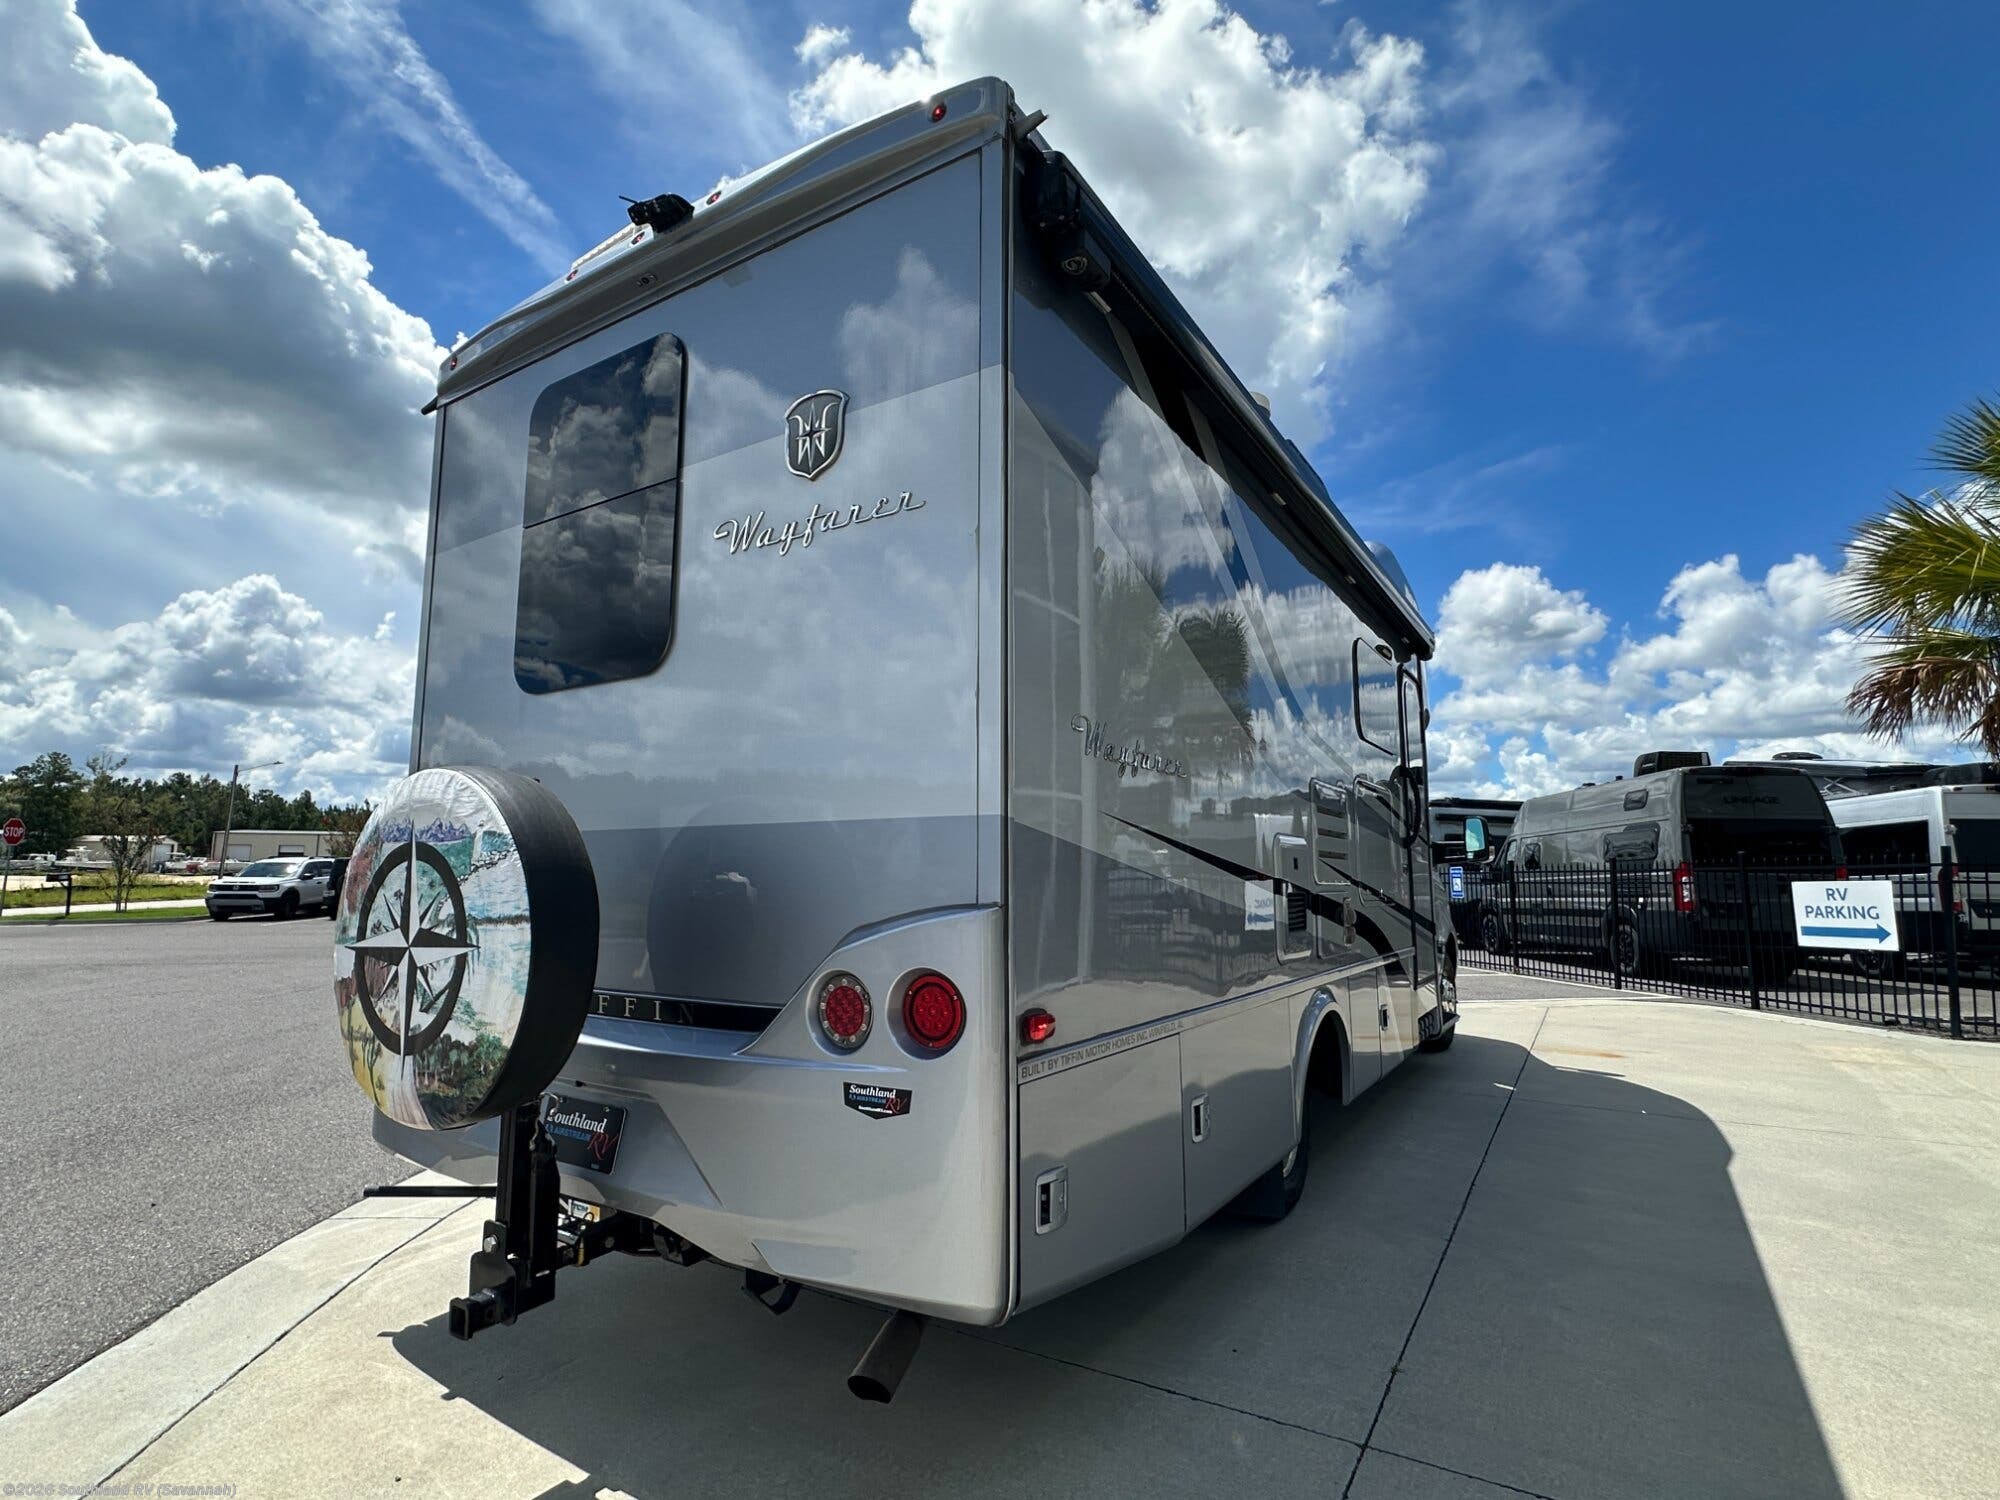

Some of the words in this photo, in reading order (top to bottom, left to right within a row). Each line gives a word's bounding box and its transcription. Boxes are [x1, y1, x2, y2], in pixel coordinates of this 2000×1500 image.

[713, 491, 927, 556] Wayfarer
[1071, 713, 1188, 778] Wayfarer
[4, 827, 24, 837] STOP
[1825, 887, 1848, 901] RV
[1804, 905, 1880, 920] PARKING
[596, 994, 698, 1025] FFIN
[1021, 1060, 1046, 1078] BUILT
[1048, 1056, 1060, 1070] BY
[1061, 1049, 1084, 1067] TIFFIN
[1085, 1041, 1111, 1058] MOTOR
[1112, 1034, 1136, 1051] HOMES
[850, 1084, 896, 1098] Southland
[885, 1097, 908, 1114] RV
[587, 1131, 619, 1160] RV
